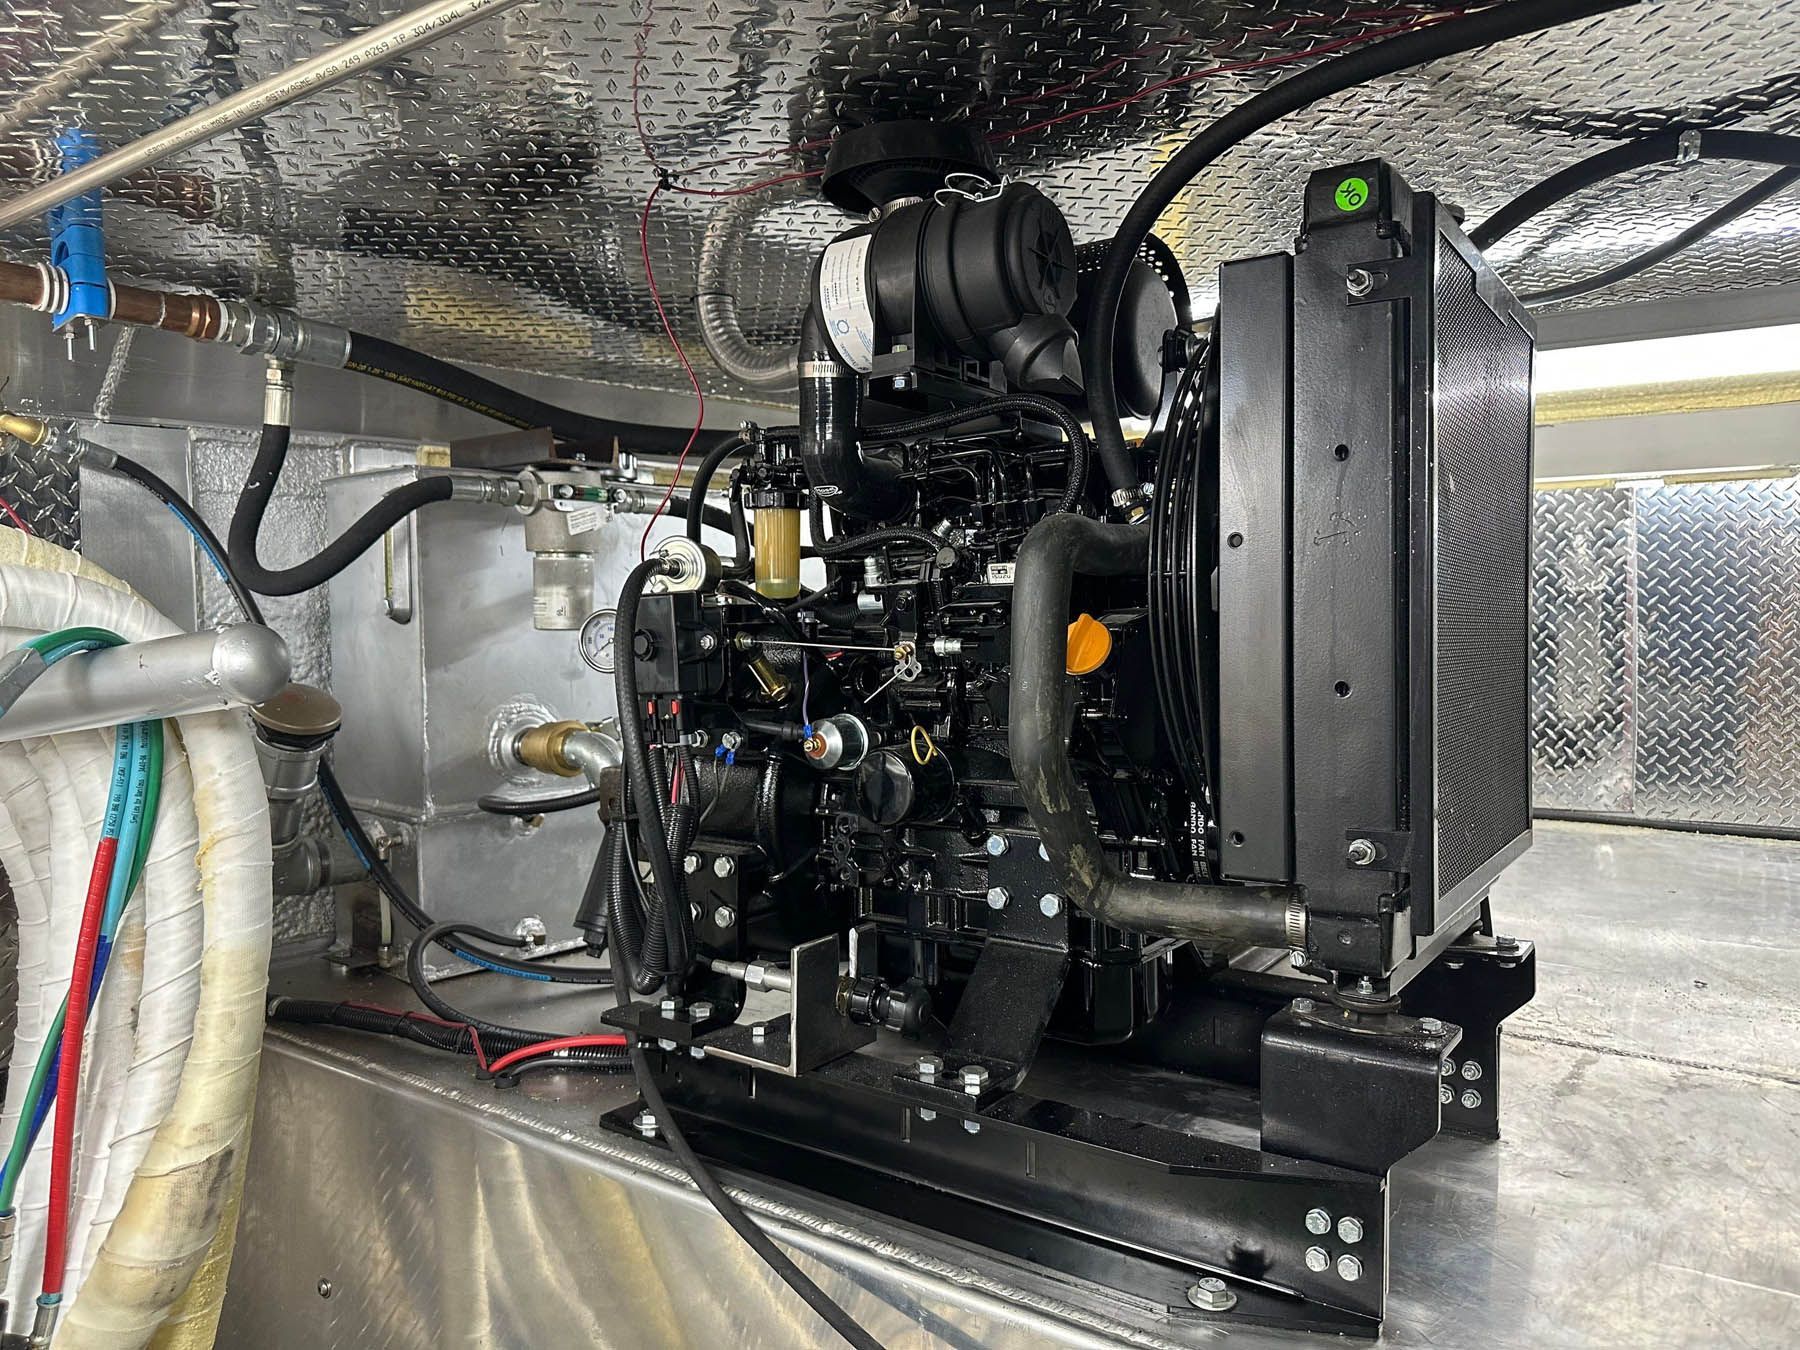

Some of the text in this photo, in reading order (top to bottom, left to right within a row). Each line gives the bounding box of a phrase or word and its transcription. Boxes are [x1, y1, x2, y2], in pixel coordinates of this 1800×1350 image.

[234, 109, 245, 119] IN
[246, 100, 265, 113] USA
[265, 77, 313, 103] ASTM/ASME
[316, 65, 340, 81] A/SA
[342, 54, 361, 69] 249
[365, 42, 390, 59] A269
[393, 33, 407, 45] TP
[412, 10, 464, 38] 304/304L
[1340, 182, 1362, 206] OK
[1198, 839, 1206, 857] FAN
